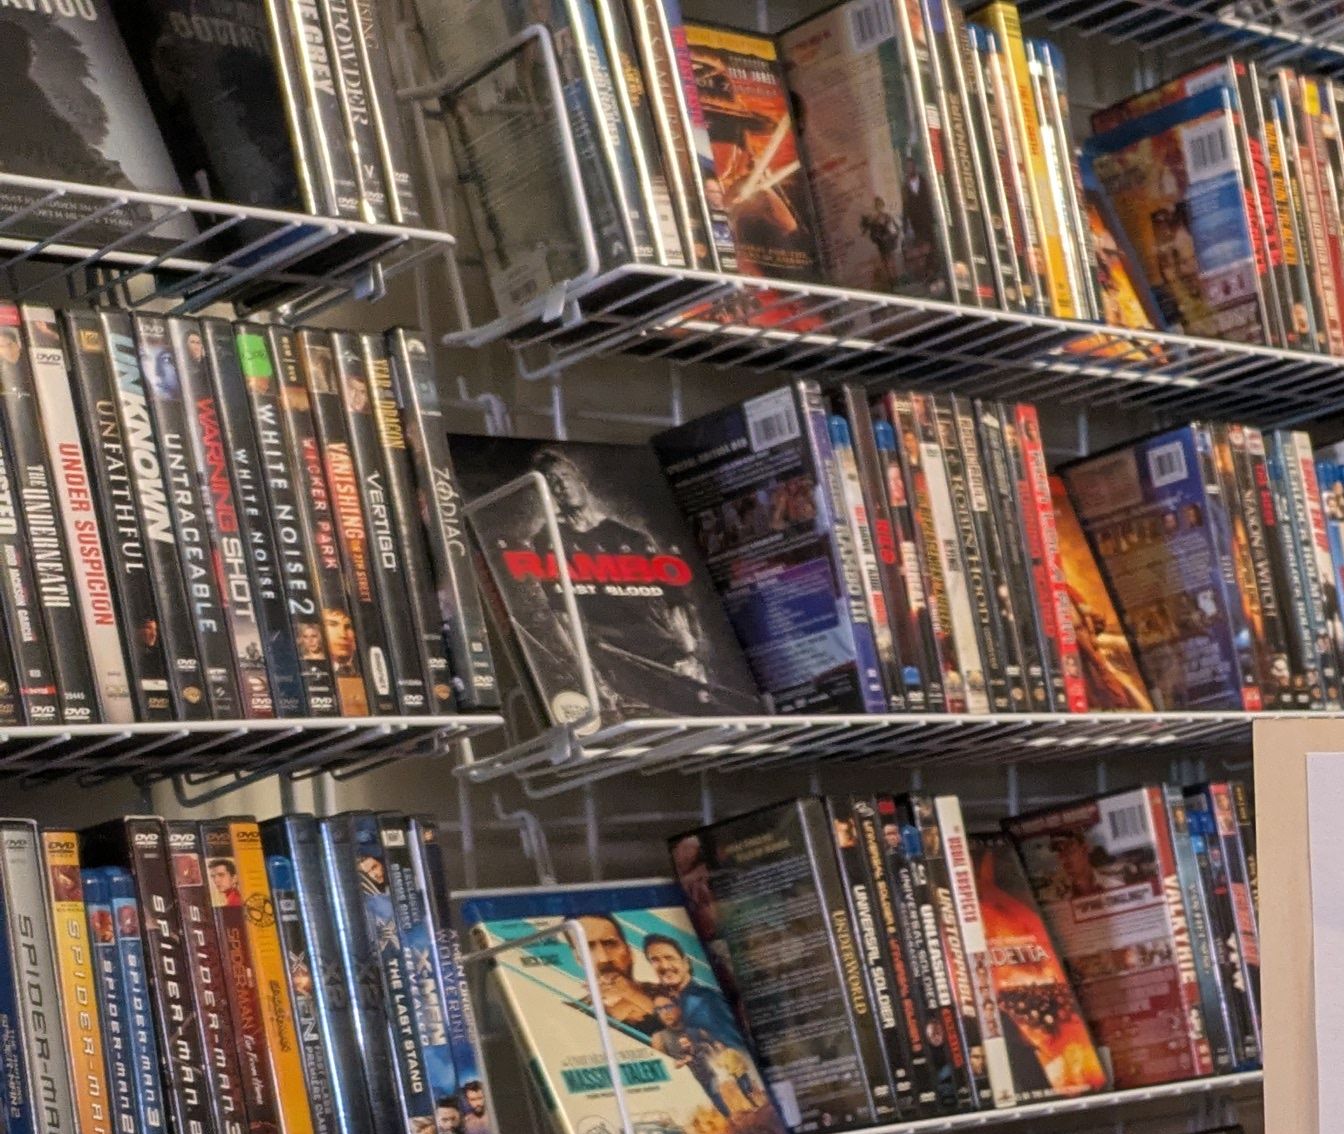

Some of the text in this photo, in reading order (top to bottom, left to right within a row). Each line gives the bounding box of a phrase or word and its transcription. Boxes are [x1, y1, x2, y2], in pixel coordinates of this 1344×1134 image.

[97, 401, 144, 573] UNFAITHFUL
[108, 332, 174, 543] UNKNOWN
[197, 398, 256, 622] WARNING SHOT
[256, 404, 314, 615] WHITE NOISE 2
[24, 487, 71, 608] UNDERNEATH
[59, 443, 114, 625] UNDER SUSPICION
[164, 433, 217, 633] UNTRACEABLE
[236, 449, 274, 600] WHITE NOISE
[366, 470, 396, 572] VERTIGO
[503, 551, 692, 586] RAMBO
[920, 903, 951, 1007] UNLEASHED
[1167, 873, 1199, 985] VALKYRIE
